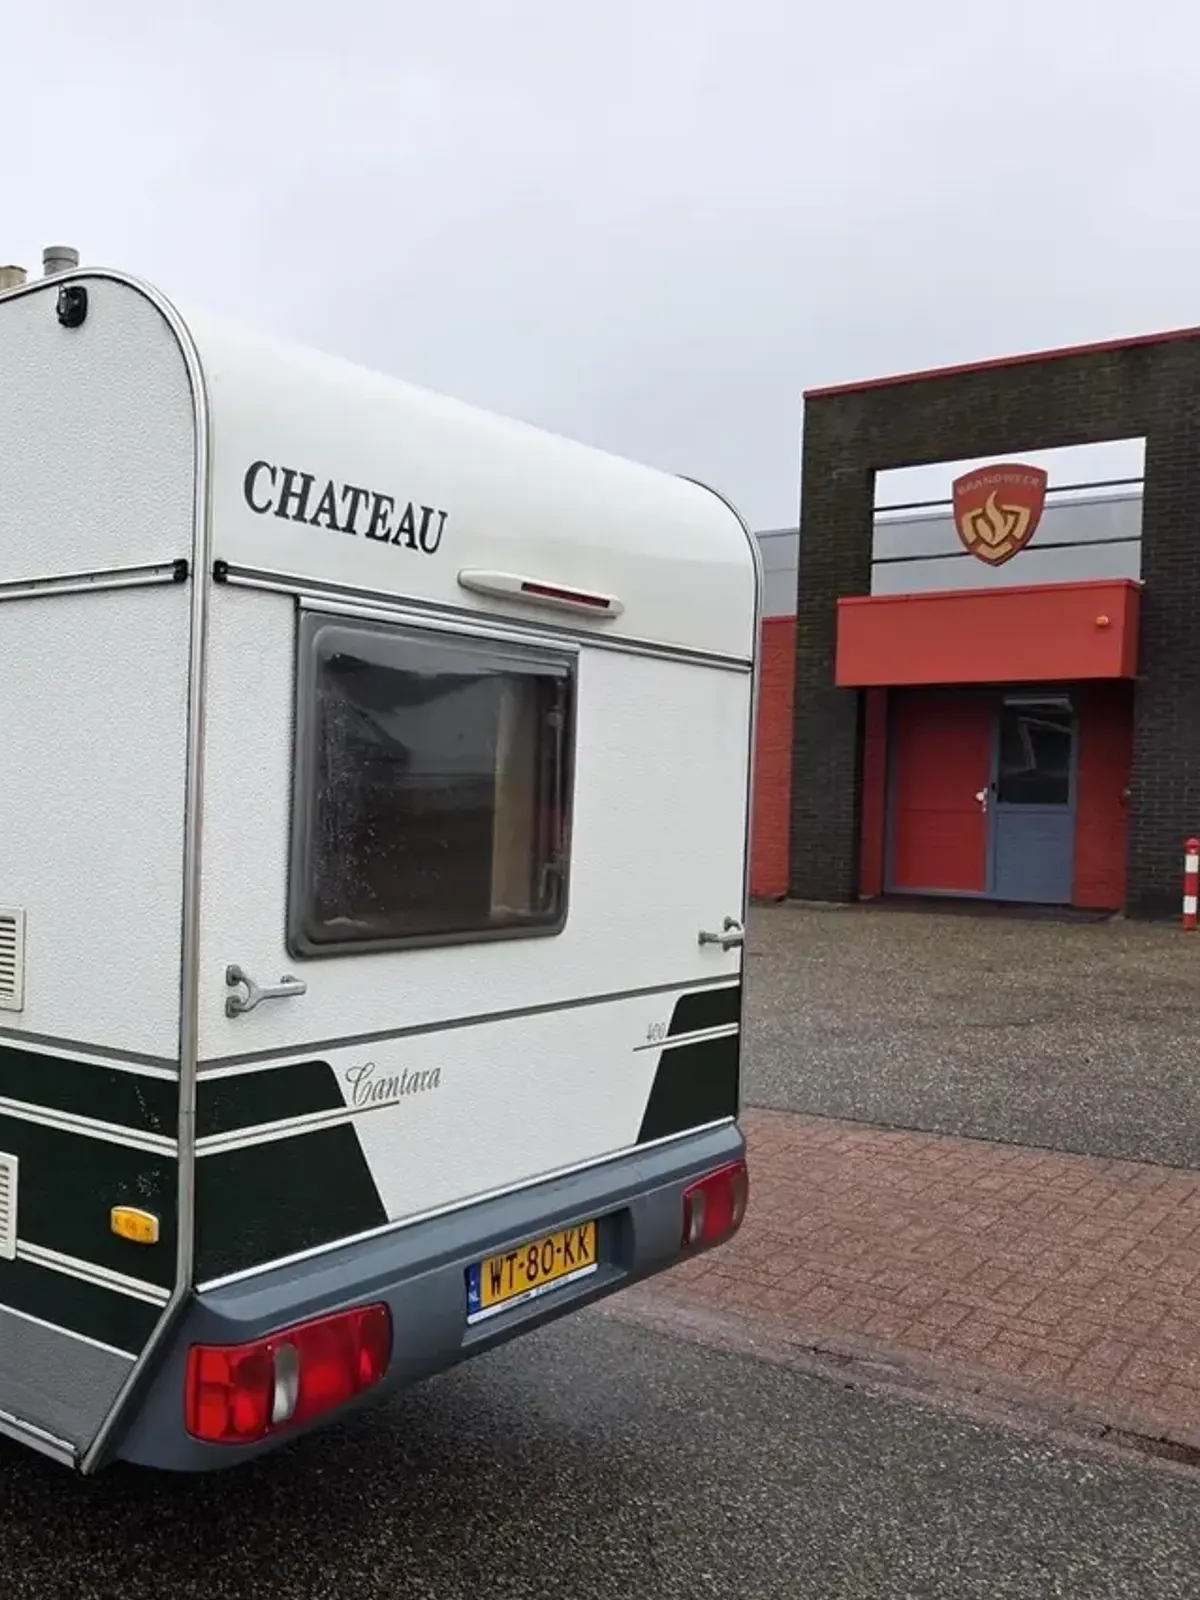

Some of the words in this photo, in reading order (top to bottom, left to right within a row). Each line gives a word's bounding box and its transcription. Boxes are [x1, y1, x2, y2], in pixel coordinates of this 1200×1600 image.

[244, 460, 448, 554] CHATEAU
[345, 1062, 441, 1107] Cantara
[490, 1226, 590, 1297] WT-80-KK
